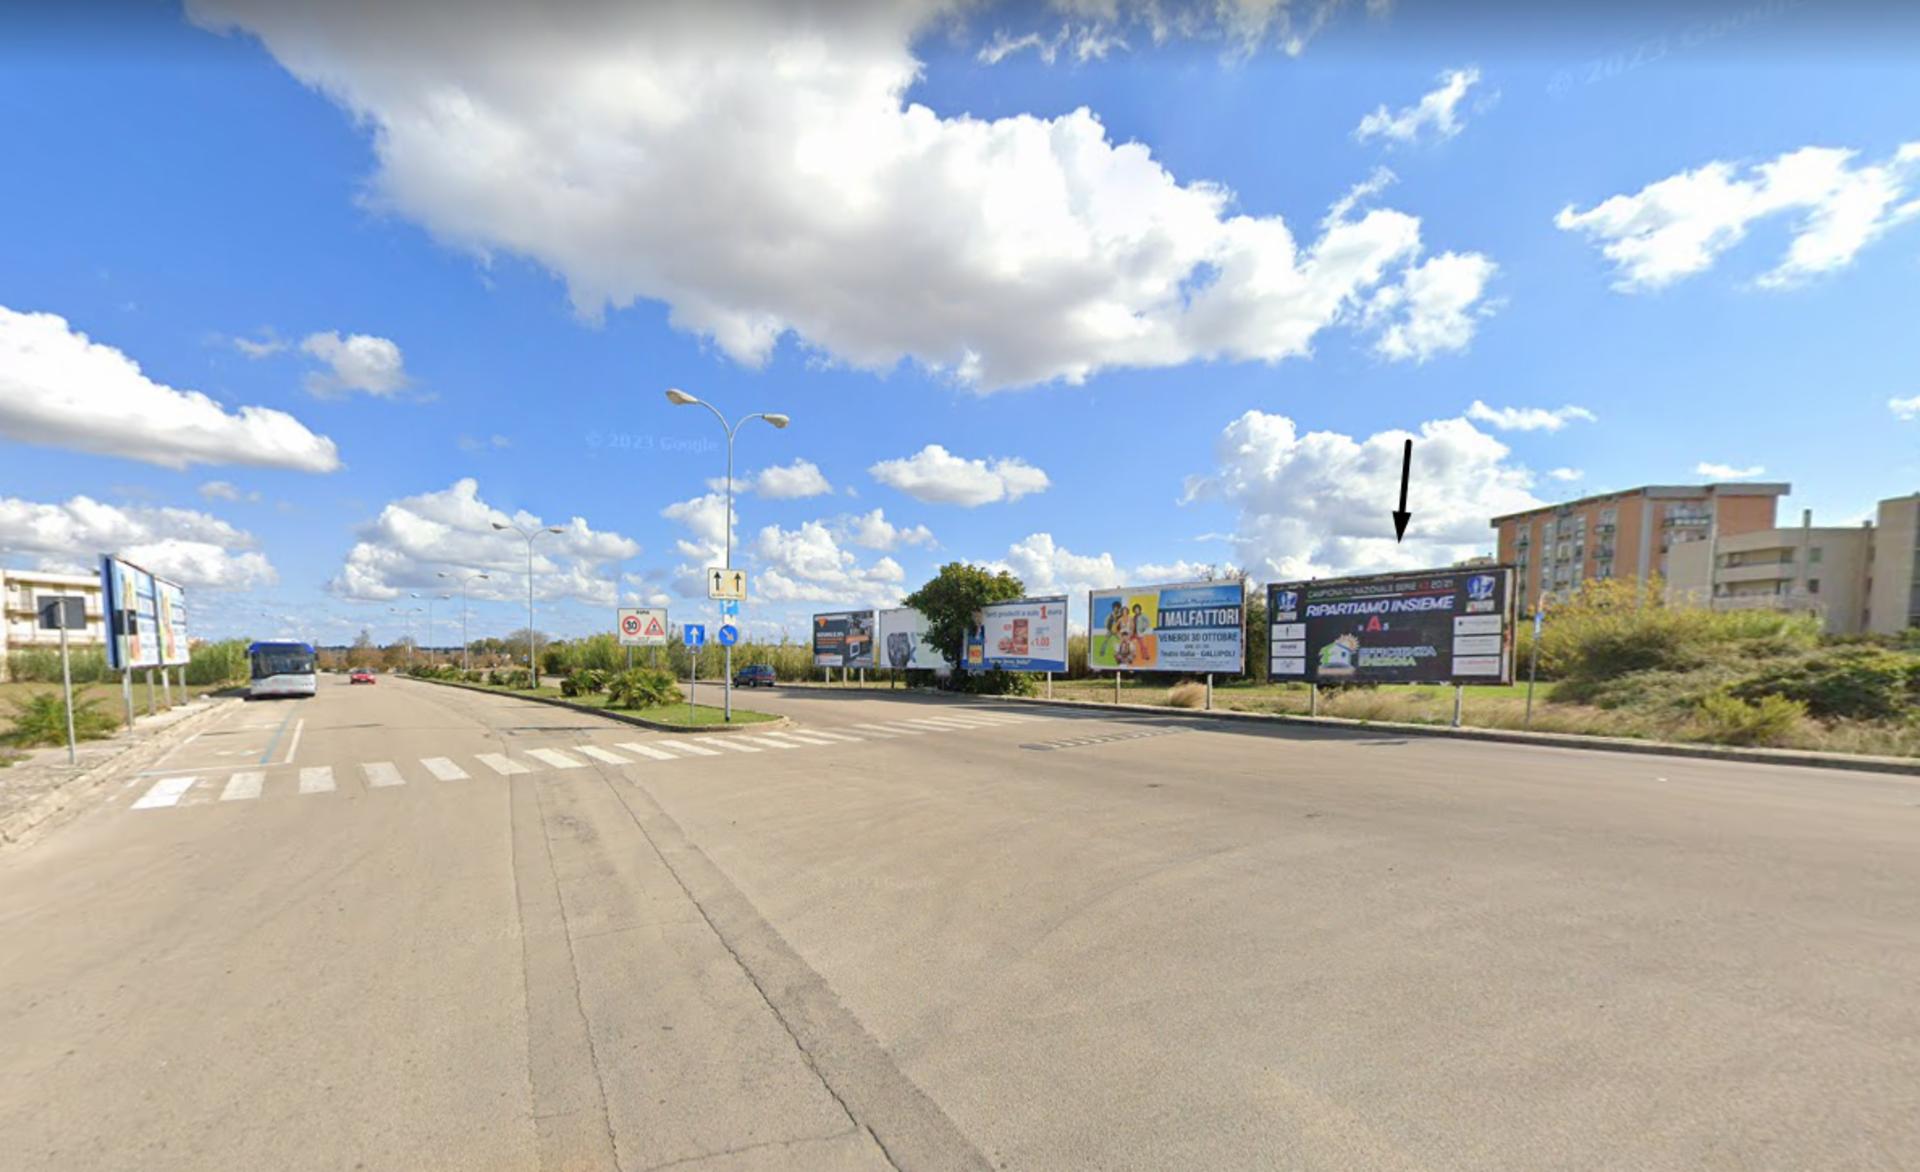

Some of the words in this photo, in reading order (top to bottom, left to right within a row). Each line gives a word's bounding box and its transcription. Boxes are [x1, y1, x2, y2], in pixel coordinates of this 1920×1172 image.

[1305, 600, 1389, 617] RIPARTIAMO
[1390, 595, 1454, 612] INSIEME
[1165, 608, 1239, 626] MALFATTORI
[626, 620, 638, 630] 30
[1202, 631, 1238, 641] OTTOBRE
[1200, 649, 1236, 658] GALLIPOLI
